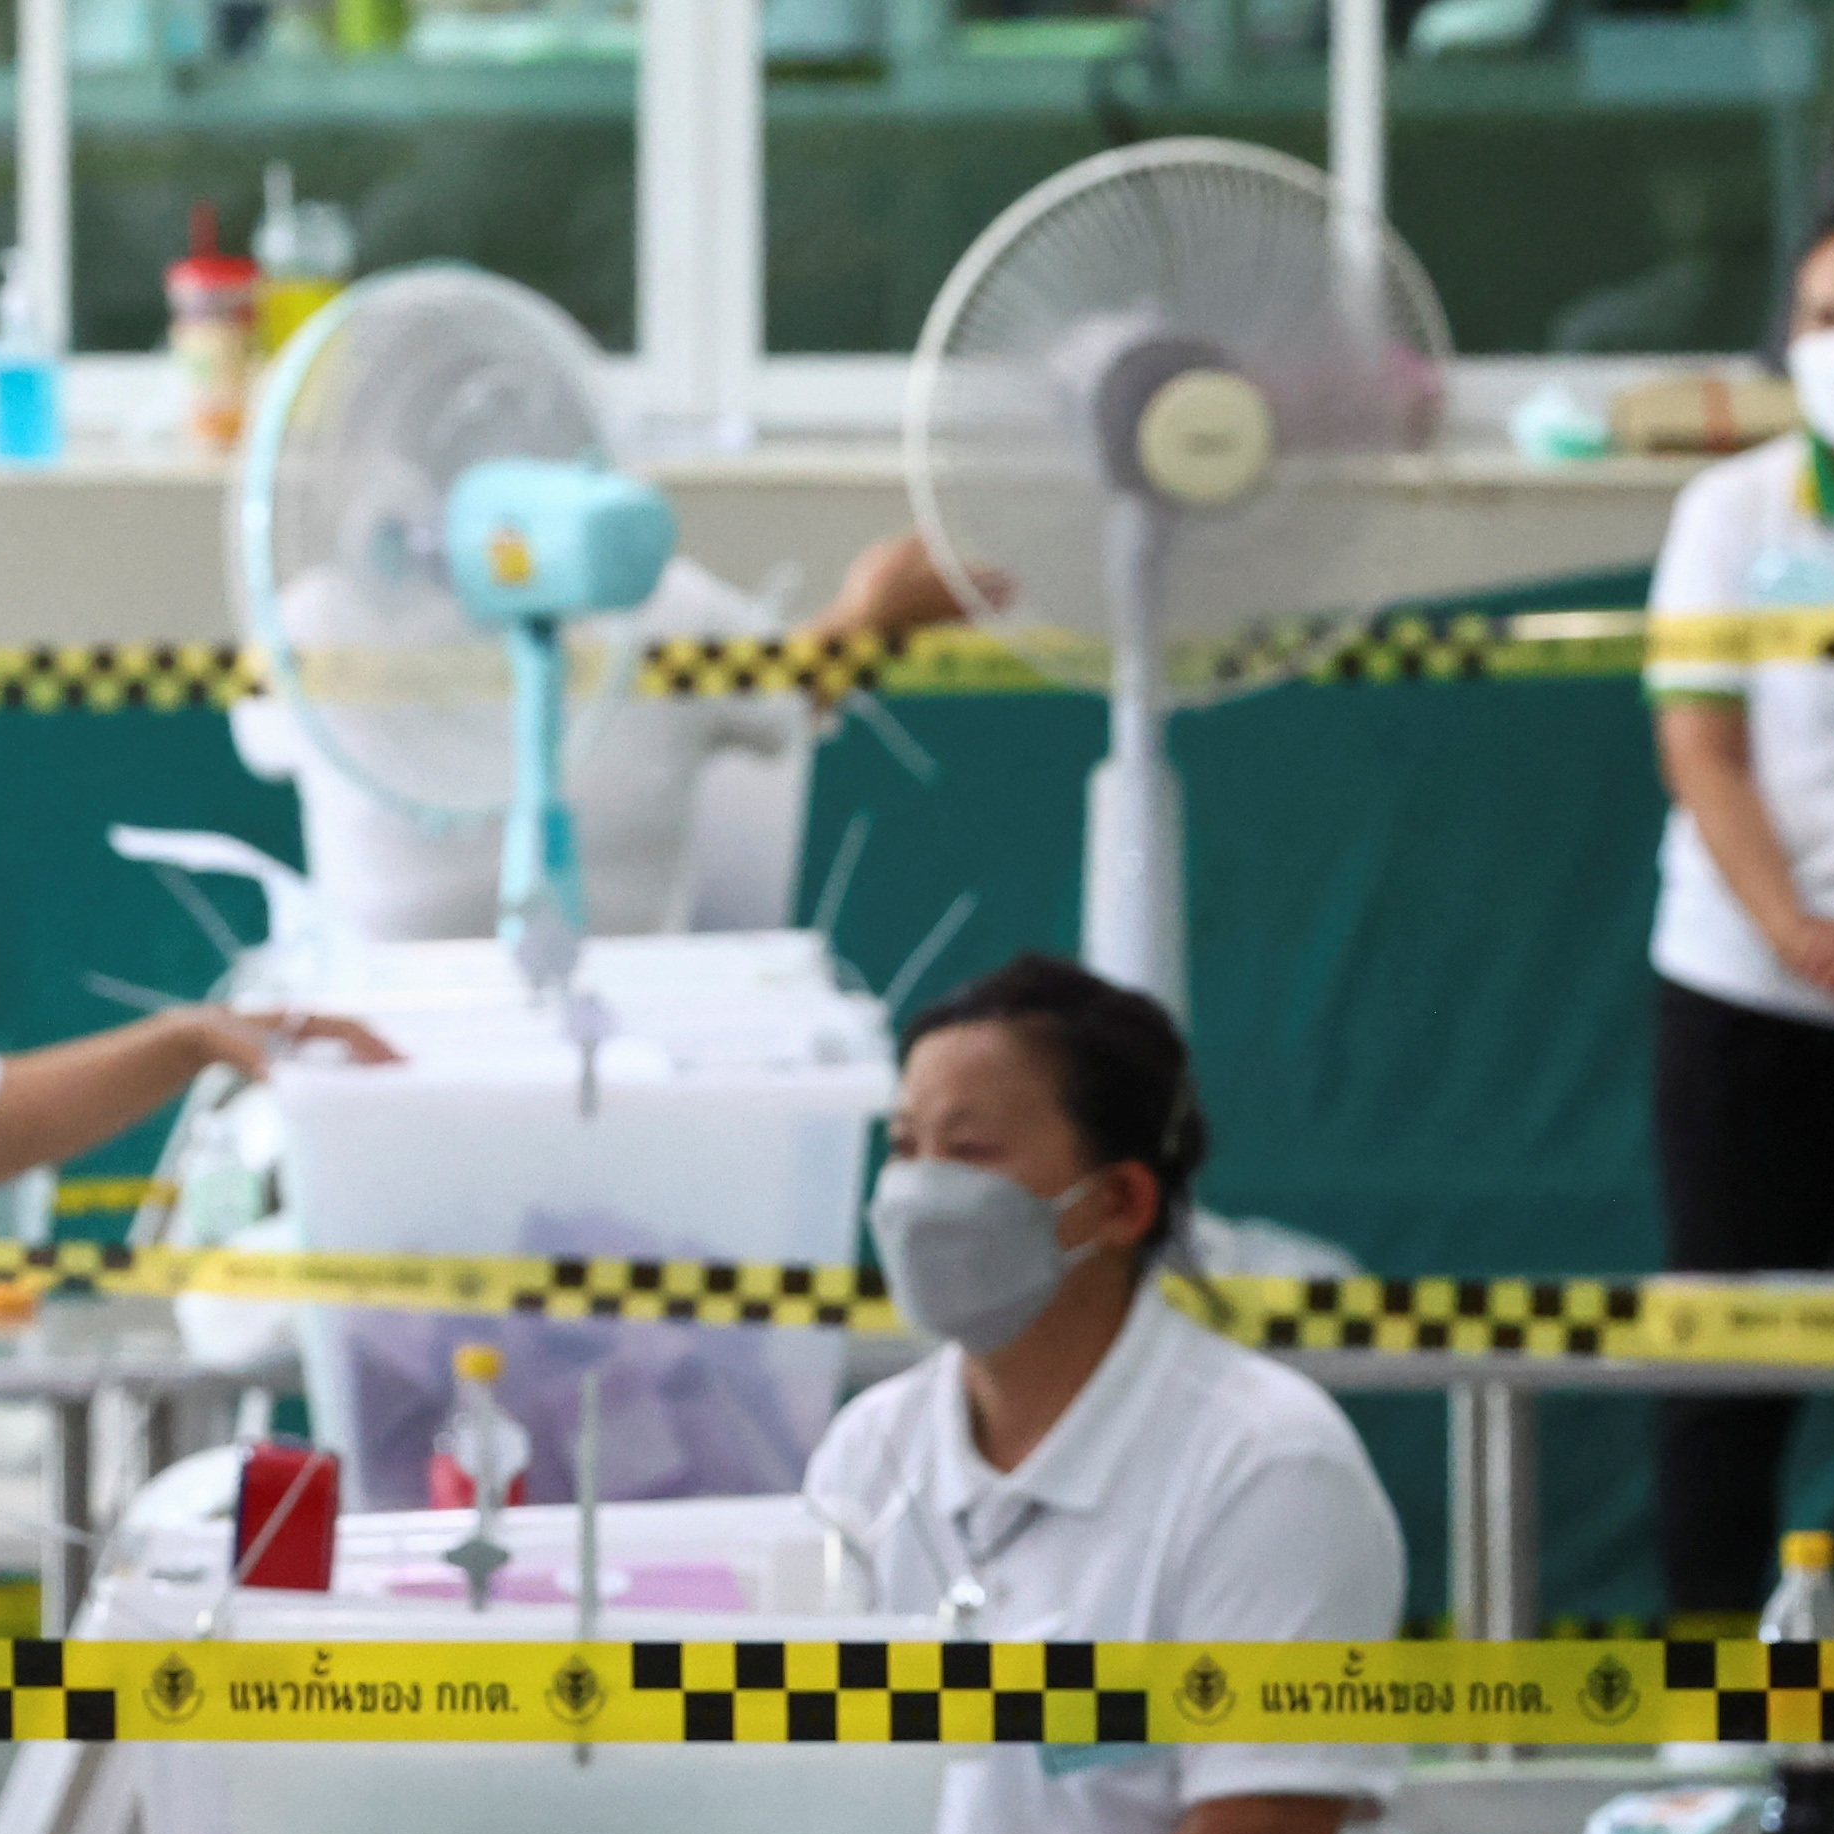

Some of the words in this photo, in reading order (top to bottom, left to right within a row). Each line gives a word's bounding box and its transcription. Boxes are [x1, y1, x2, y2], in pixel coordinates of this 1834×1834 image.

[229, 1650, 422, 1713] แนวกั้นของ
[436, 1681, 519, 1714] กกต.
[1262, 1650, 1455, 1714] แนวกั้นของ
[1468, 1681, 1553, 1714] กกต.
